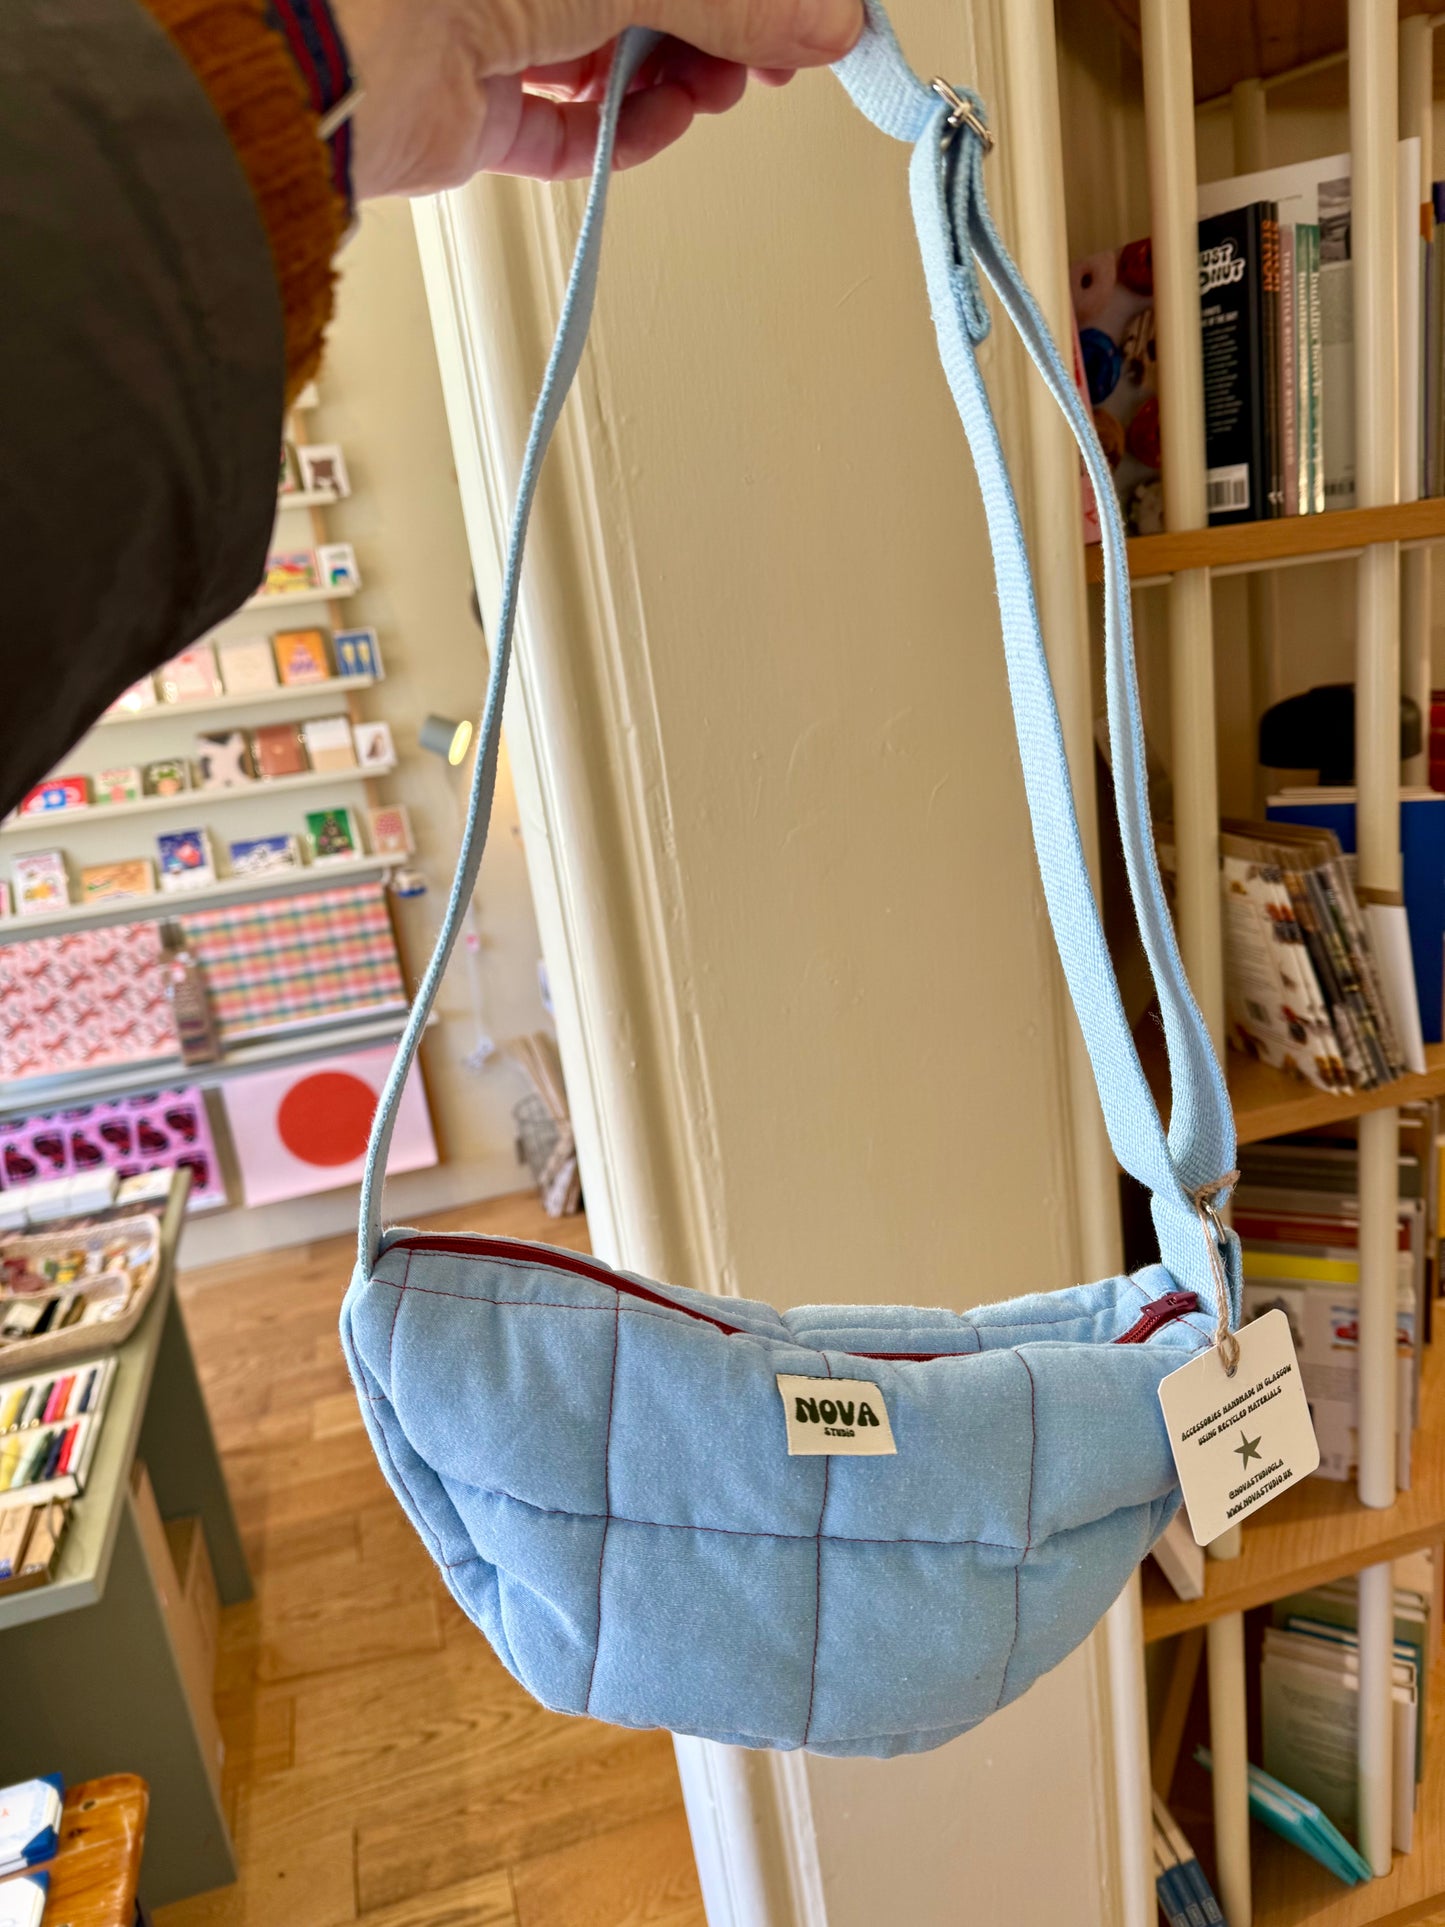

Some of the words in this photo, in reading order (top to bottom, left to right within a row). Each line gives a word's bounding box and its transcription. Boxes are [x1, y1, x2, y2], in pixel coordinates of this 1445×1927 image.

[1283, 251, 1291, 275] THE
[1283, 280, 1292, 322] LITTLE
[1284, 326, 1293, 363] BOOK
[795, 1397, 880, 1427] NOVA
[1181, 1409, 1222, 1442] ACCESSORIES
[1222, 1387, 1256, 1415] HANDMADE
[1256, 1381, 1264, 1393] IN
[1264, 1363, 1292, 1386] GLASGOW
[1198, 1428, 1217, 1446] USING
[1217, 1409, 1247, 1434] RECYCLED
[1247, 1385, 1282, 1414] MATERIALS
[824, 1427, 856, 1438] STUDIO
[1226, 1468, 1293, 1519] WWW.NOVASTUDIO.UK
[1228, 1458, 1284, 1500] @NOVASTUDIOGLA
